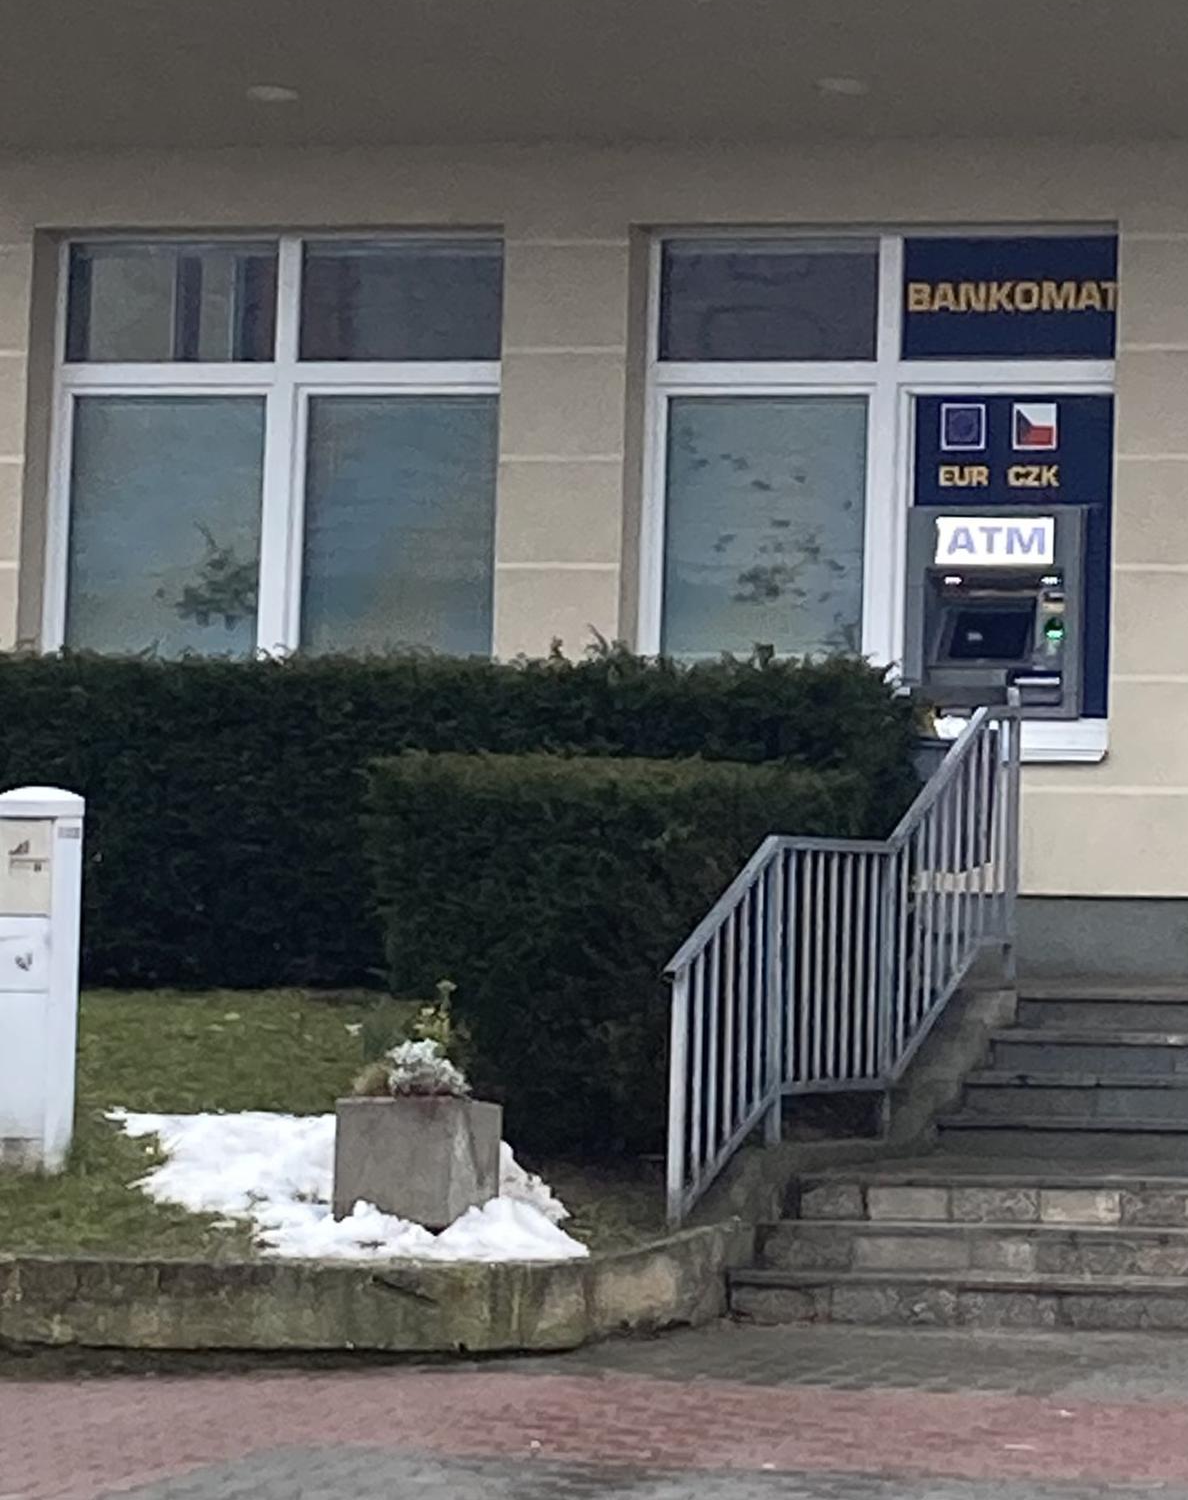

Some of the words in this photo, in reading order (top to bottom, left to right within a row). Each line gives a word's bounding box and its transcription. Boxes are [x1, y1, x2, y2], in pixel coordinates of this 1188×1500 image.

[908, 281, 1118, 312] BANKOMAT
[939, 466, 989, 487] EUR
[1008, 465, 1060, 487] CZK
[946, 526, 1047, 556] ATM
